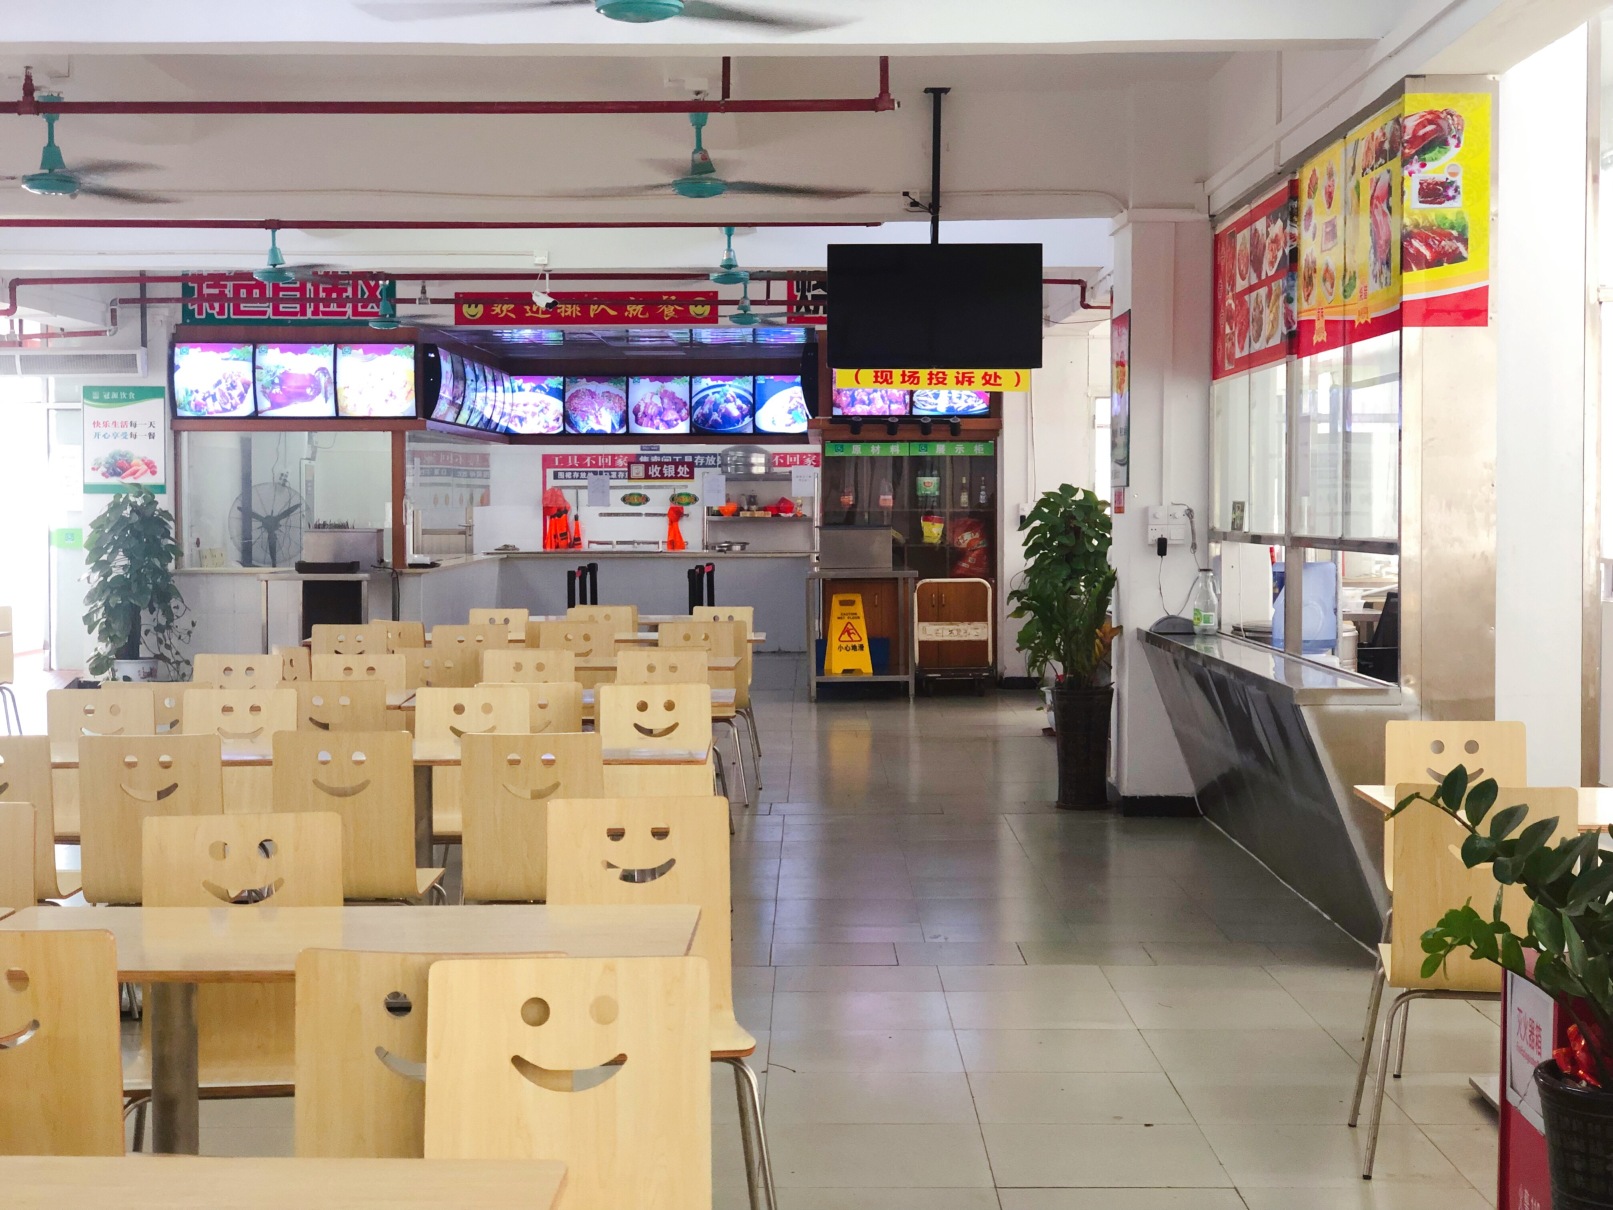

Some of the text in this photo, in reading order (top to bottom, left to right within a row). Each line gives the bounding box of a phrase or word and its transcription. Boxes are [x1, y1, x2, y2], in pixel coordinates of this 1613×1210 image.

[490, 295, 684, 320] 欢迎排队就餐
[92, 420, 156, 429] 快乐生活每一天
[93, 431, 156, 440] 开心享受每一餐
[851, 444, 986, 455] 原材料 展示柜
[553, 455, 629, 467] 工具不回家
[648, 464, 690, 478] 收银处
[837, 644, 865, 652] 小心地滑
